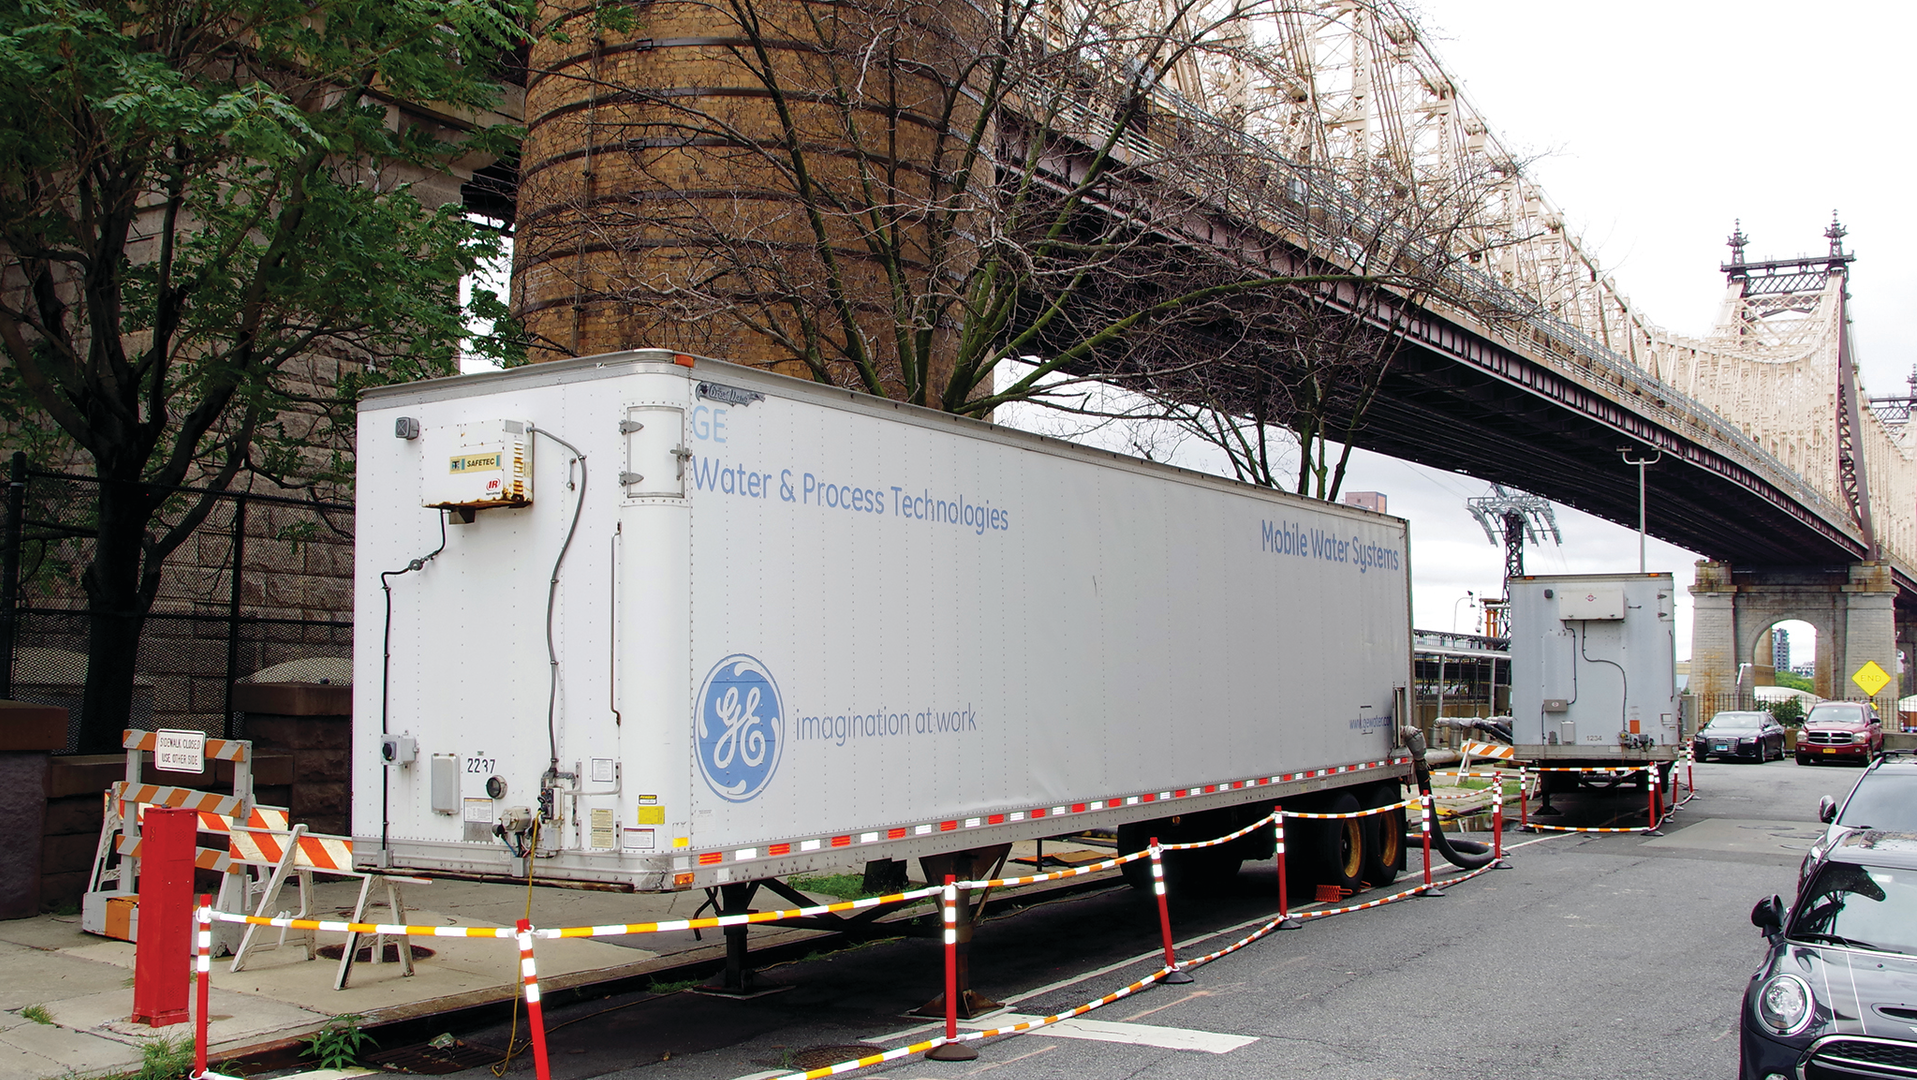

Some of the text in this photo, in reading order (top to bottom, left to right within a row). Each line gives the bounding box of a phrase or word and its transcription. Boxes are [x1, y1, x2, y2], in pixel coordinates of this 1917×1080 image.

[692, 405, 727, 443] GE
[467, 458, 495, 467] SAFETEC
[692, 455, 1009, 535] Water & Process Technologies
[1261, 519, 1399, 574] Mobile Water Systems
[1860, 674, 1882, 682] END
[796, 702, 977, 747] imagination at work
[160, 737, 201, 749] SIDEWALK CLOSED
[162, 753, 198, 765] USE OTHER SIDE
[467, 758, 496, 774] 2237
